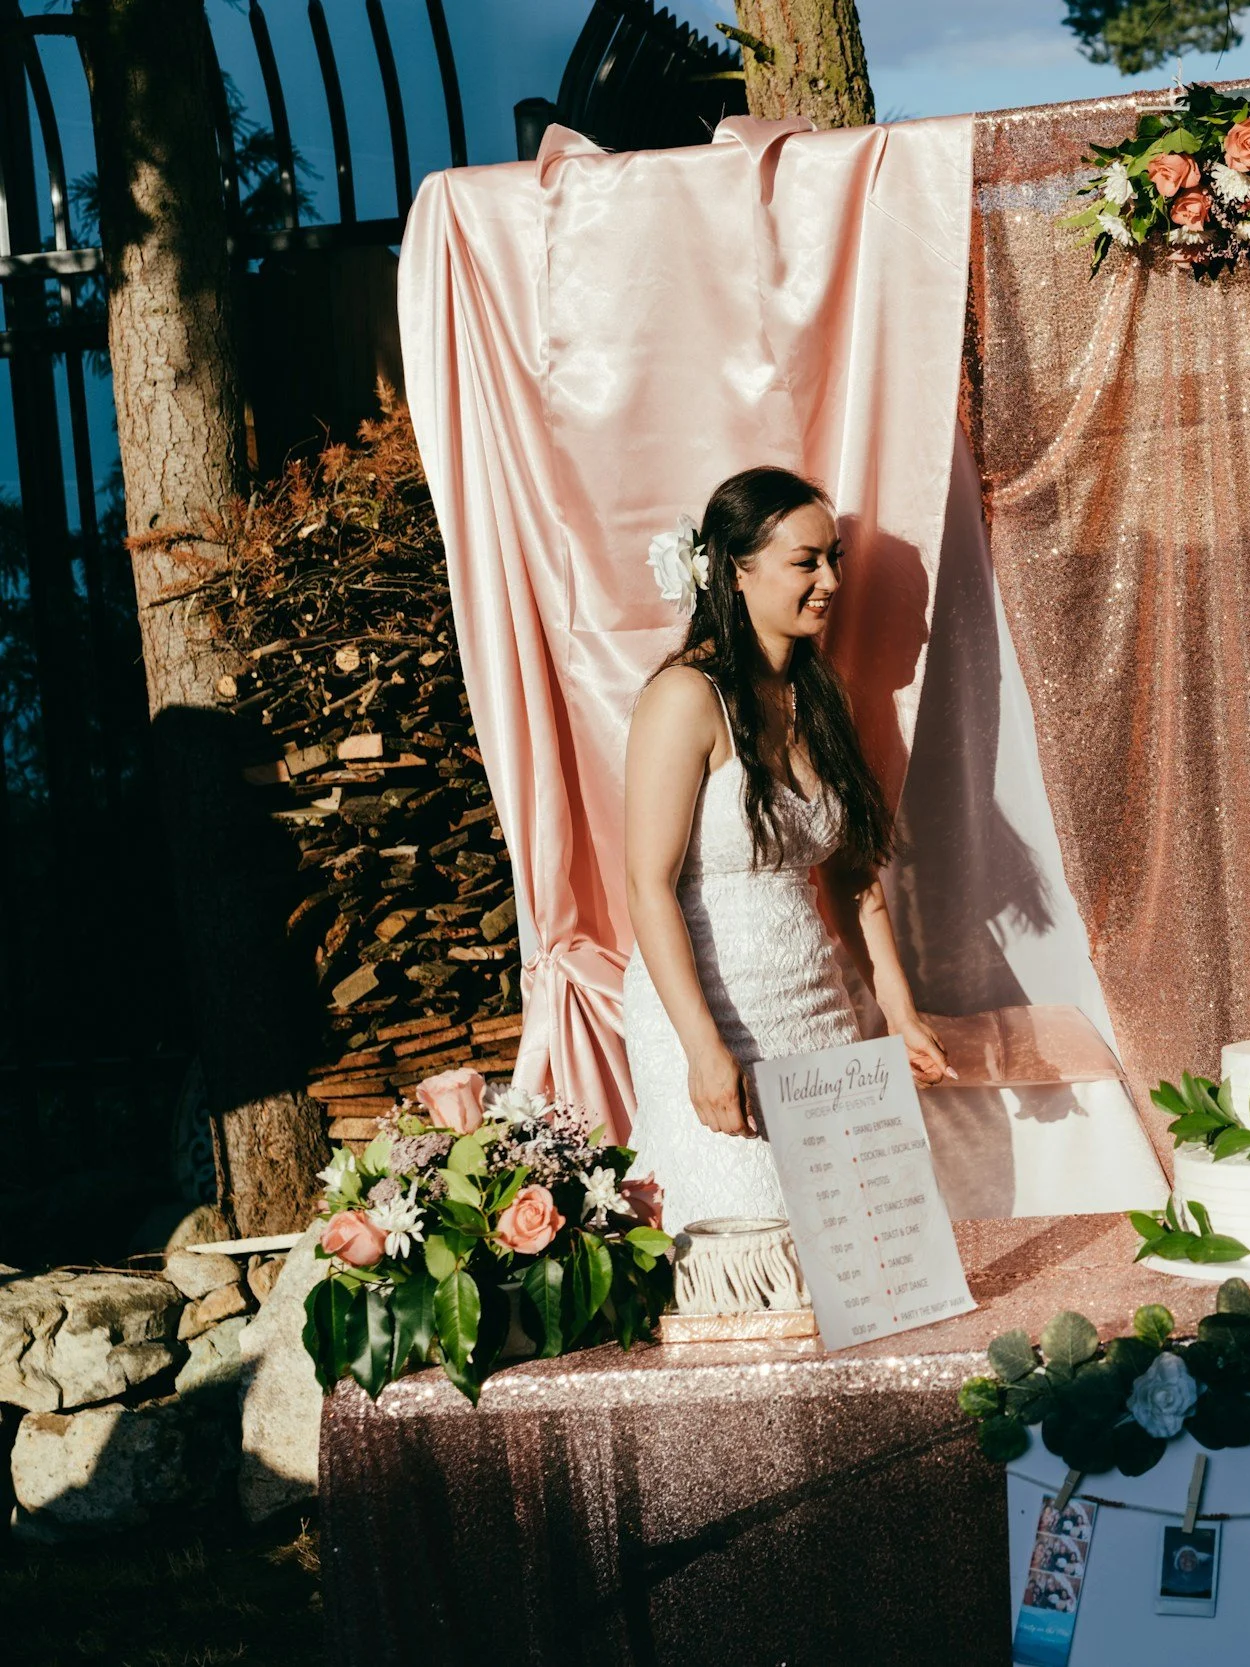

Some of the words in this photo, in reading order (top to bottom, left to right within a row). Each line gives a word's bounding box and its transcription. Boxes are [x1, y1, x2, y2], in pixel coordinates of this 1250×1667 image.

[778, 1067, 843, 1112] Wedding
[845, 1057, 889, 1101] Party
[804, 1104, 832, 1120] ORDER
[845, 1095, 876, 1112] EVENTS
[852, 1121, 873, 1135] GRAND
[873, 1116, 902, 1133] ENTRANCE
[860, 1147, 887, 1161] COCKTAIL
[892, 1142, 910, 1156] SOCIAL
[867, 1175, 890, 1188] PHOTOS
[895, 1282, 910, 1296] LAST
[910, 1278, 928, 1292] DANCE
[901, 1309, 918, 1322] PARTY
[918, 1306, 931, 1318] THE
[931, 1302, 948, 1315] NIGHT
